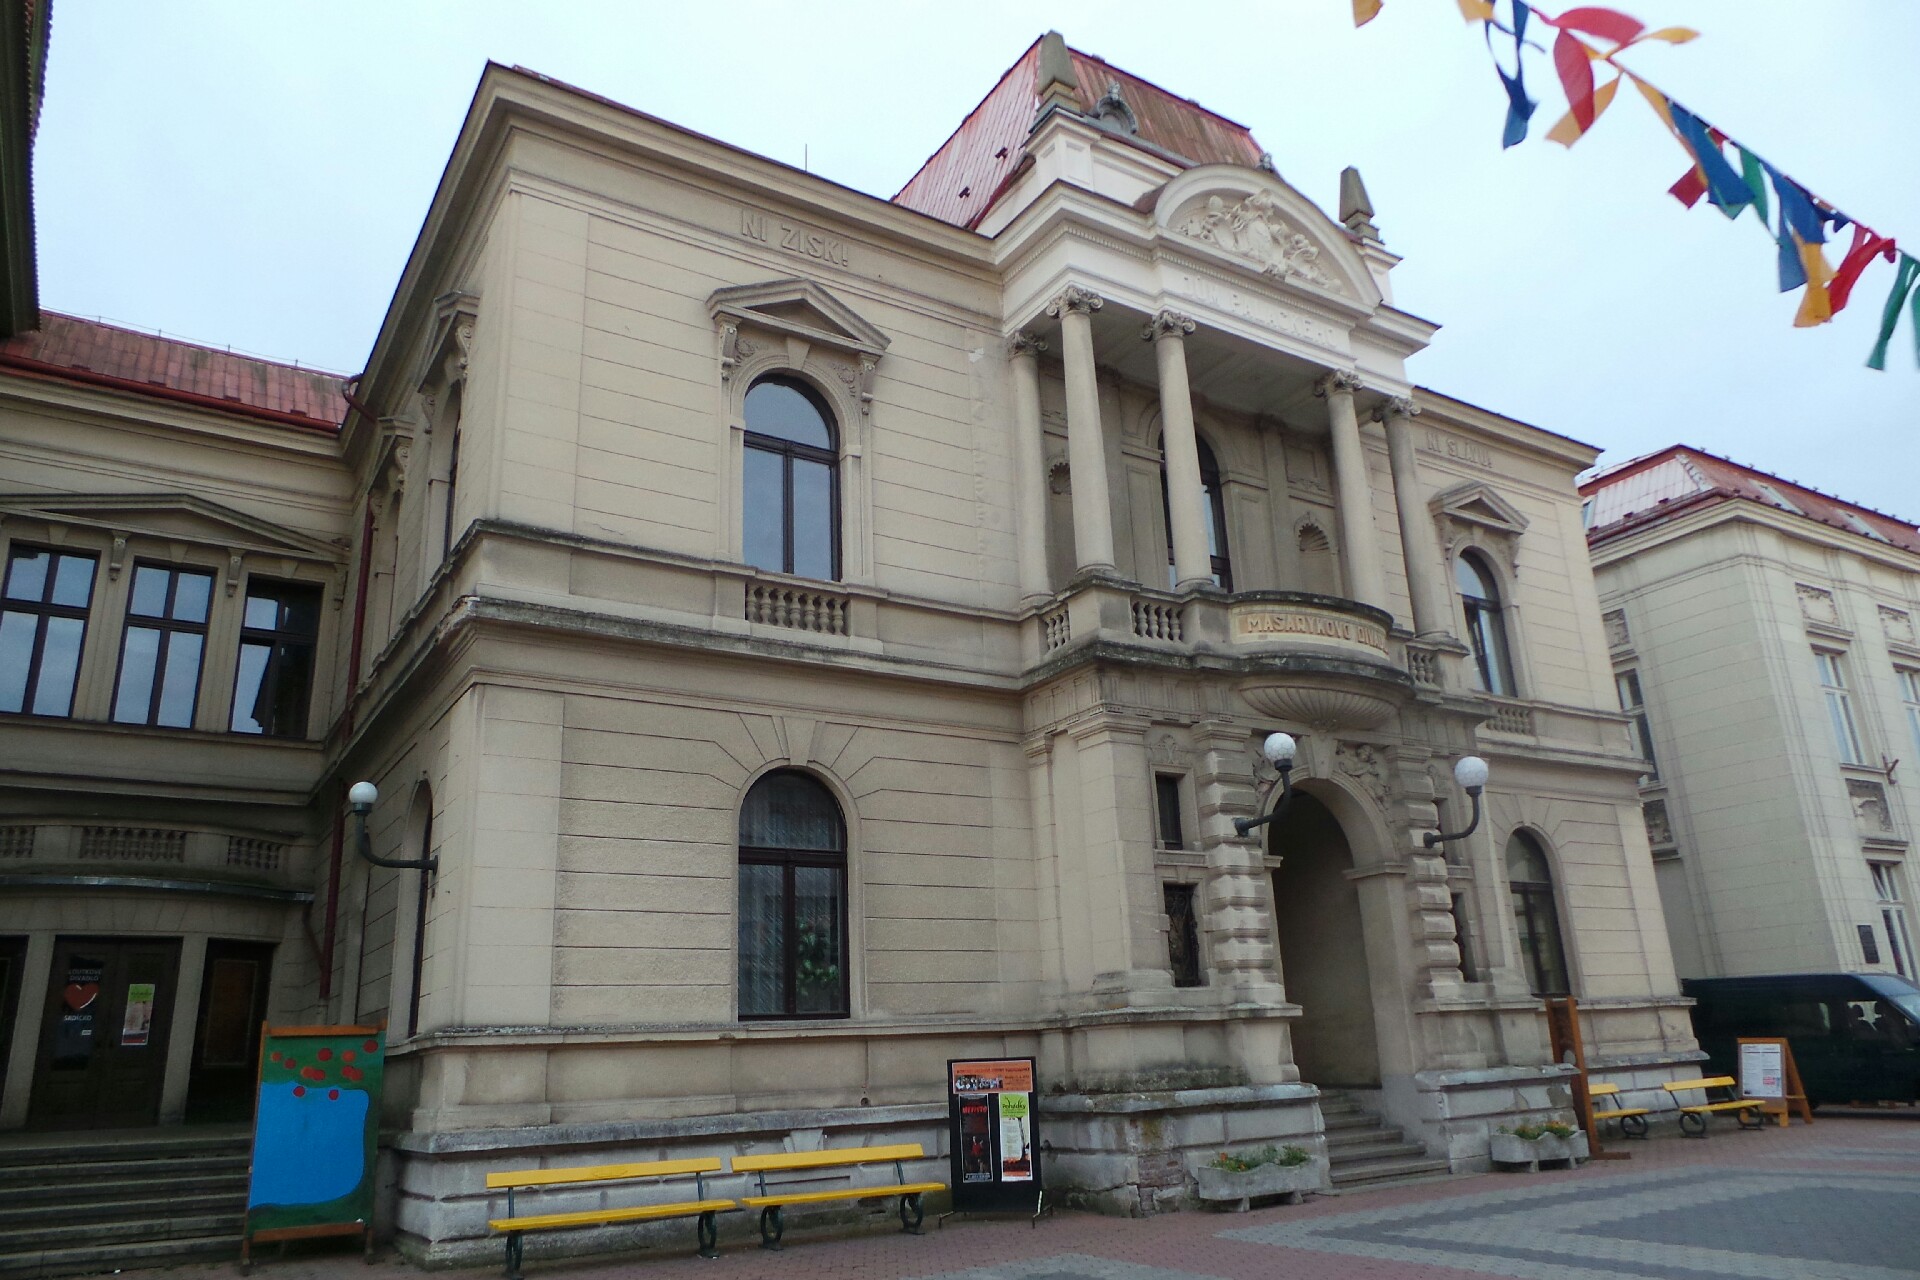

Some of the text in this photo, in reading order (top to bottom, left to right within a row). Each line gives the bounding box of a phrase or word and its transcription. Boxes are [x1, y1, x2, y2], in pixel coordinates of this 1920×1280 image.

[741, 209, 848, 267] NI ZISK!
[1247, 613, 1351, 640] MASARYKOVO
